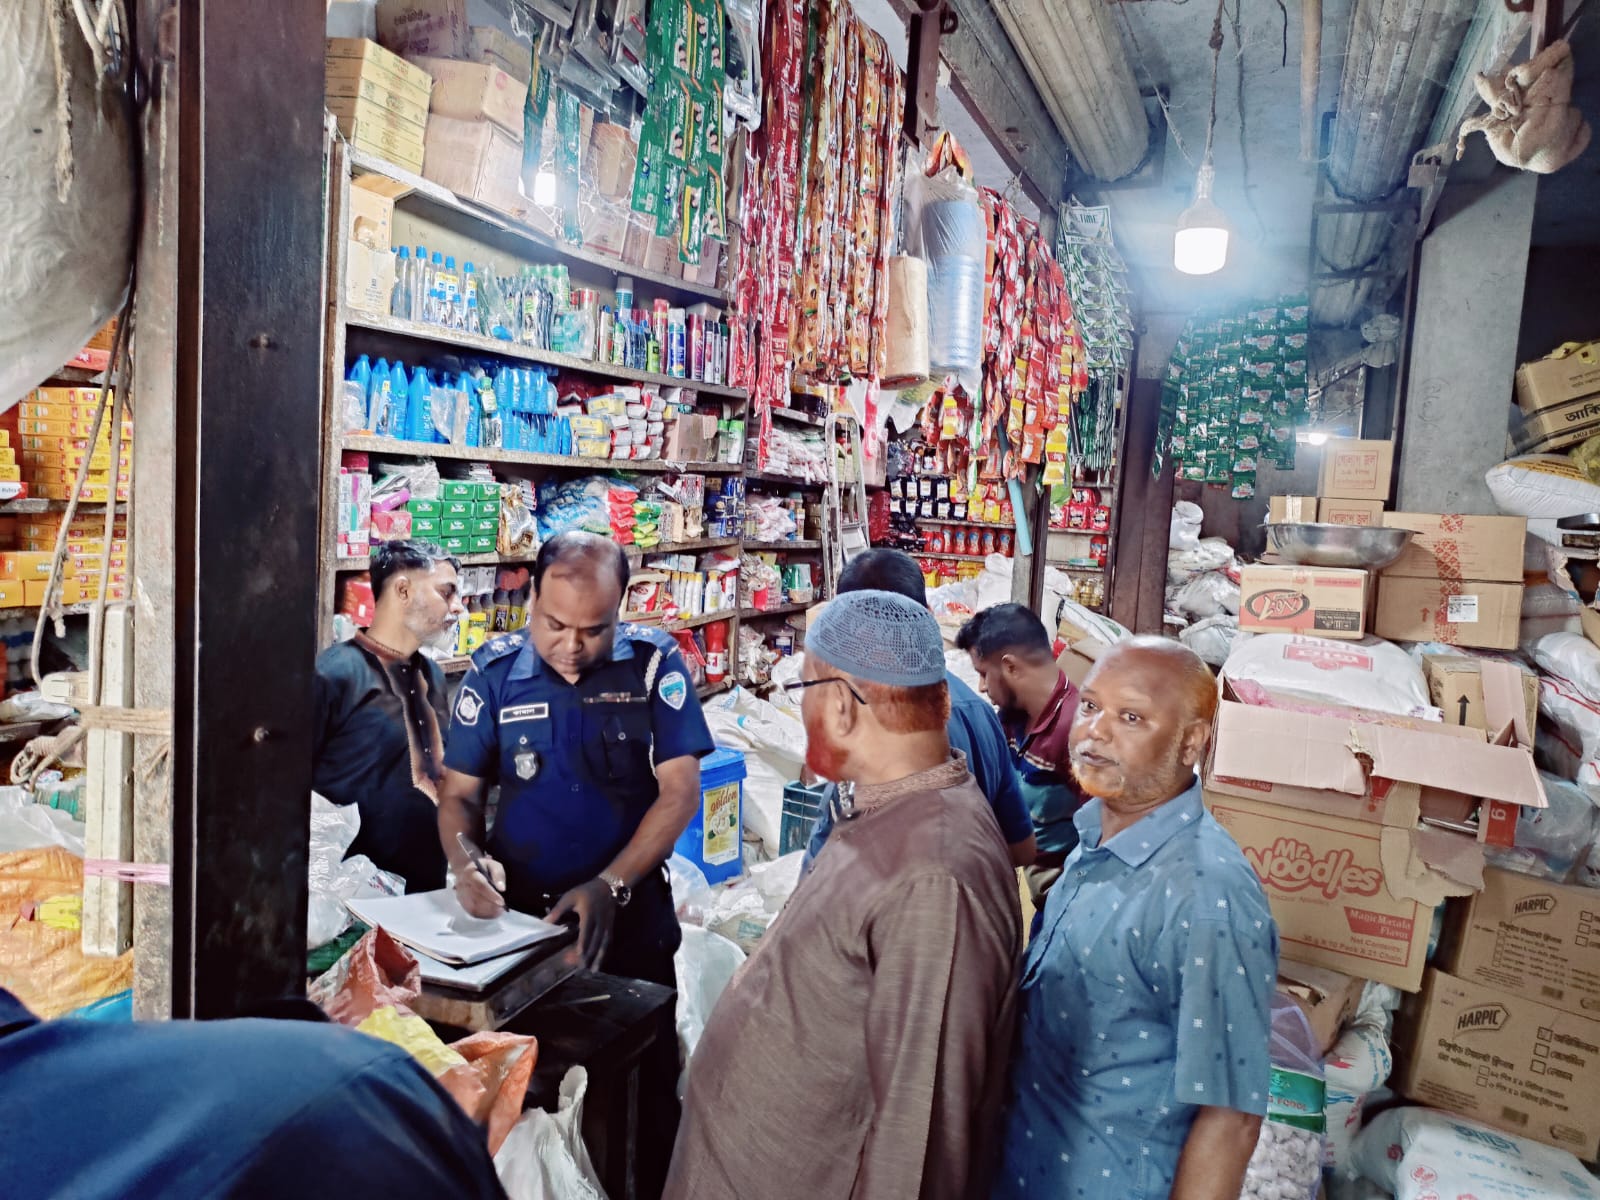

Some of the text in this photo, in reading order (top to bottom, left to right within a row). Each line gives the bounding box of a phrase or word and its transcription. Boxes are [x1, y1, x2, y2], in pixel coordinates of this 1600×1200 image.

[1564, 403, 1600, 422] আকি
[1273, 837, 1313, 861] Mr.
[1243, 847, 1384, 899] Noodles
[1514, 897, 1551, 915] HARPIC
[1350, 908, 1377, 924] Magic
[1380, 925, 1410, 939] Flavor
[1457, 1009, 1501, 1030] HARPIC
